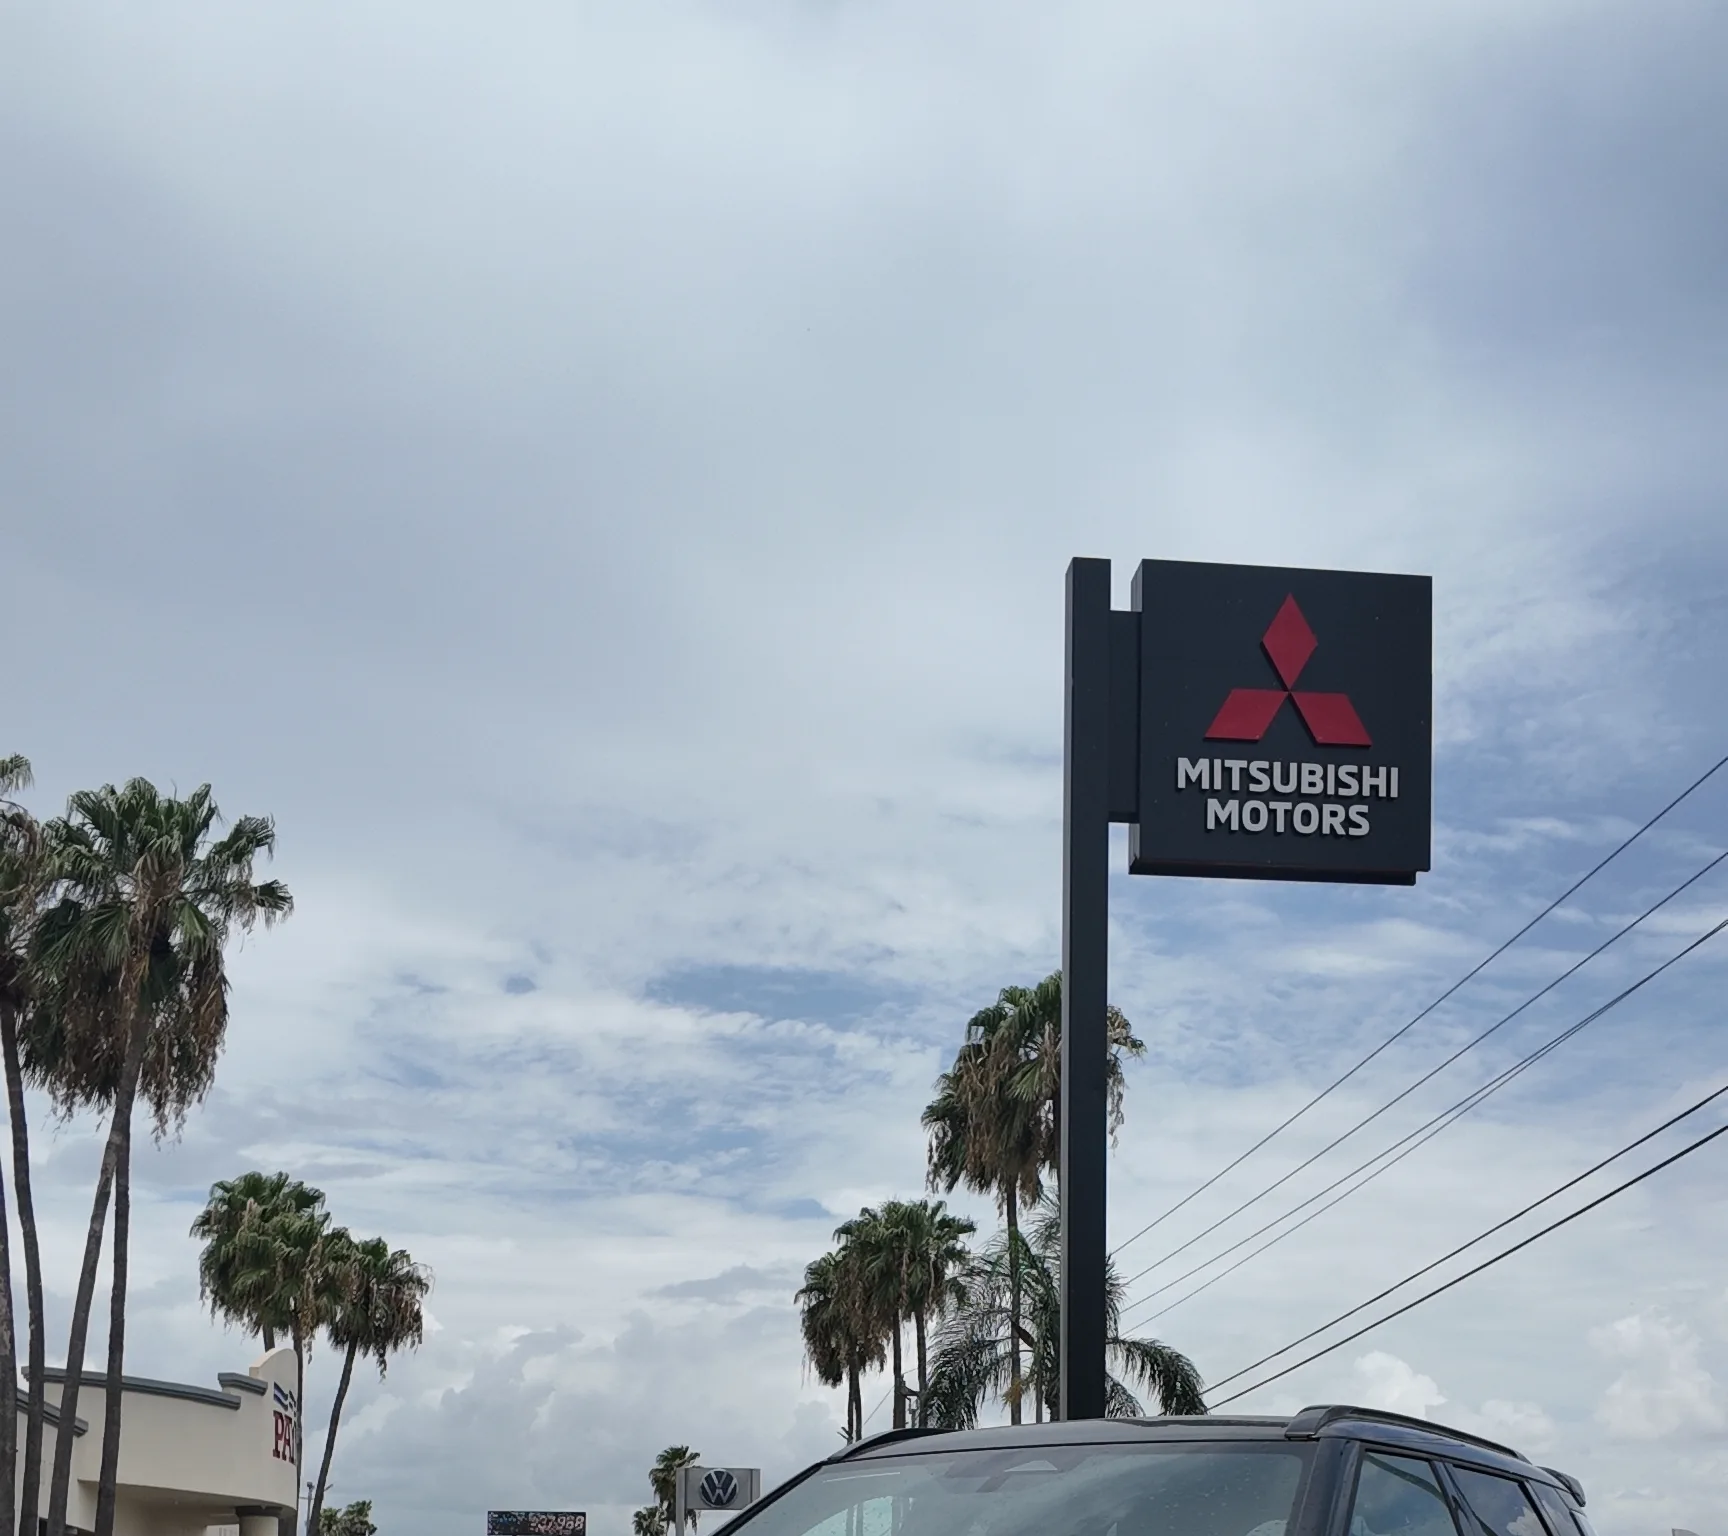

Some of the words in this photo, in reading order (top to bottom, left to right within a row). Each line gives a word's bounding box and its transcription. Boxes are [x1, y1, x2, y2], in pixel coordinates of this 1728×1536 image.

[1177, 757, 1399, 798] MITSUBISHI
[1206, 798, 1370, 836] MOTORS
[700, 1468, 738, 1507] VW
